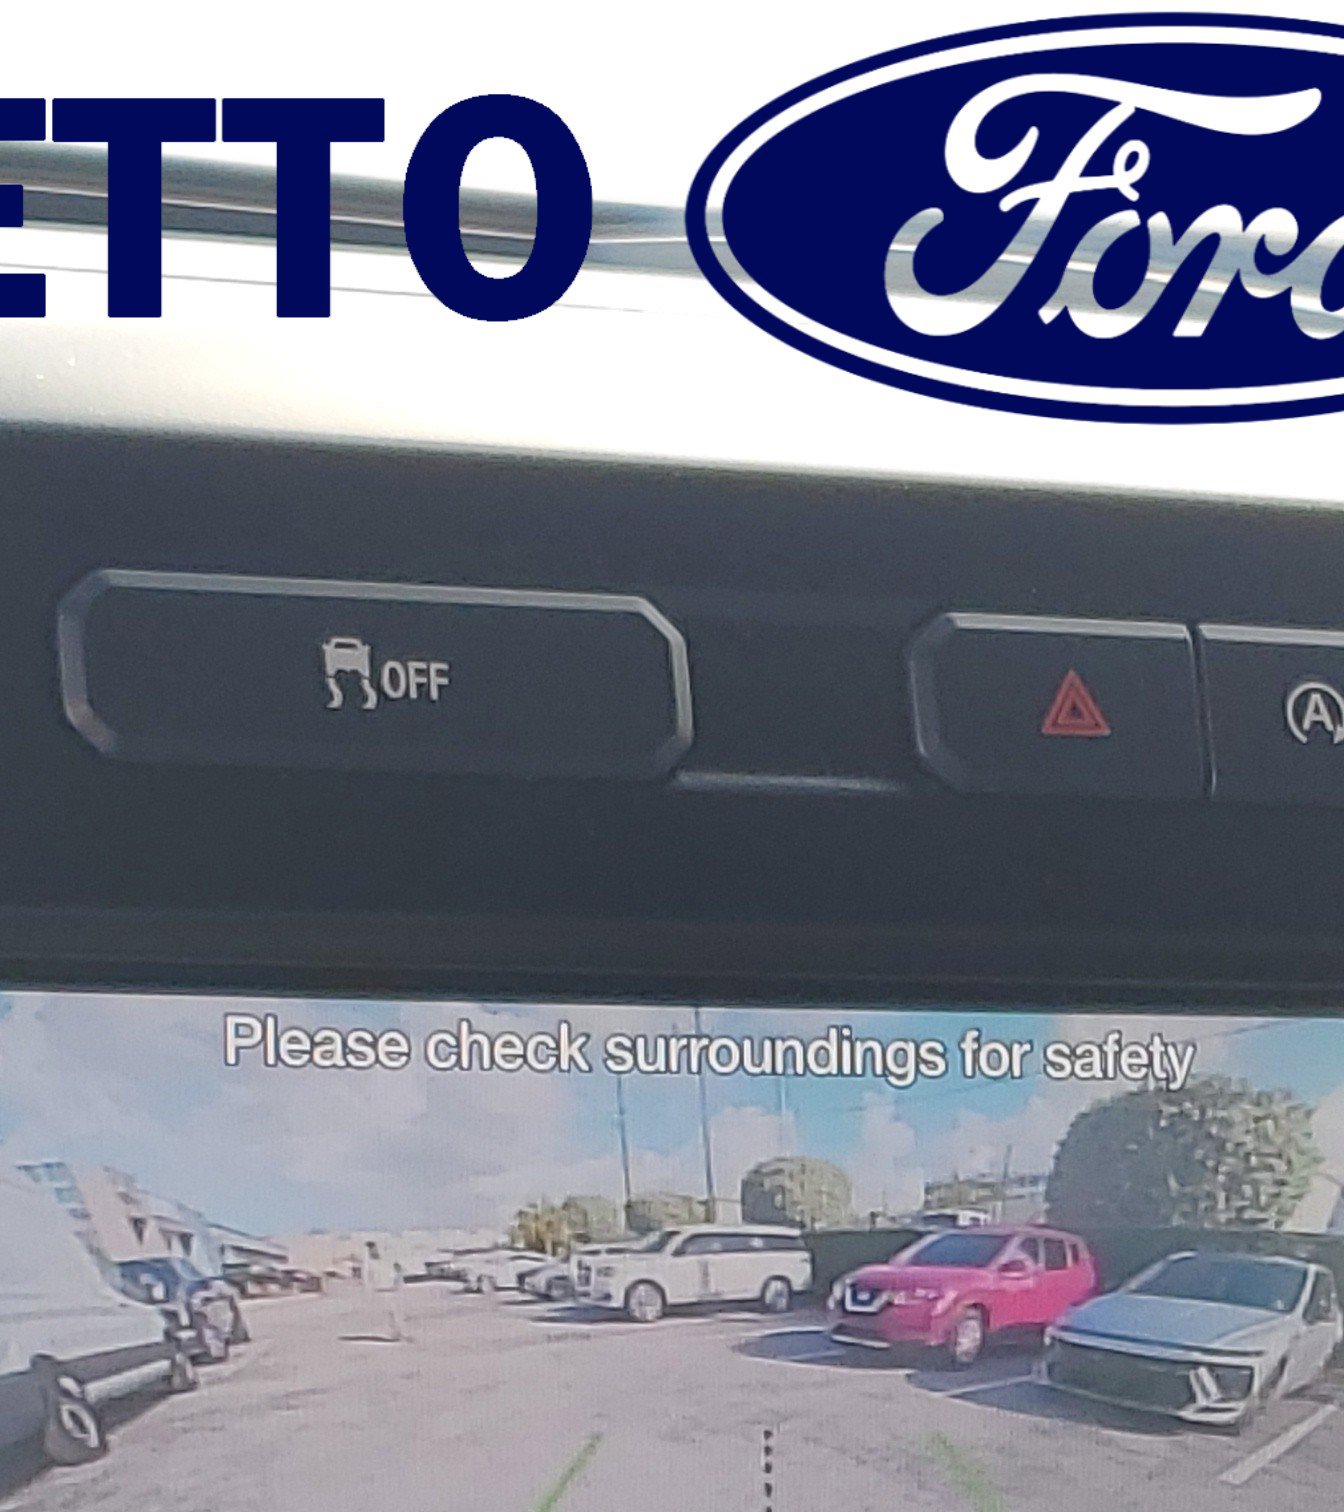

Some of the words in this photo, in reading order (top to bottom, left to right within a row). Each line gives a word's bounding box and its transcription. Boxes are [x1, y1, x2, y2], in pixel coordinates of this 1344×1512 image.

[380, 661, 450, 702] OFF
[223, 1012, 412, 1070] Please
[424, 1019, 592, 1074] check
[604, 1026, 946, 1089] surroundings
[959, 1028, 1034, 1080] for
[1043, 1031, 1198, 1092] safety
